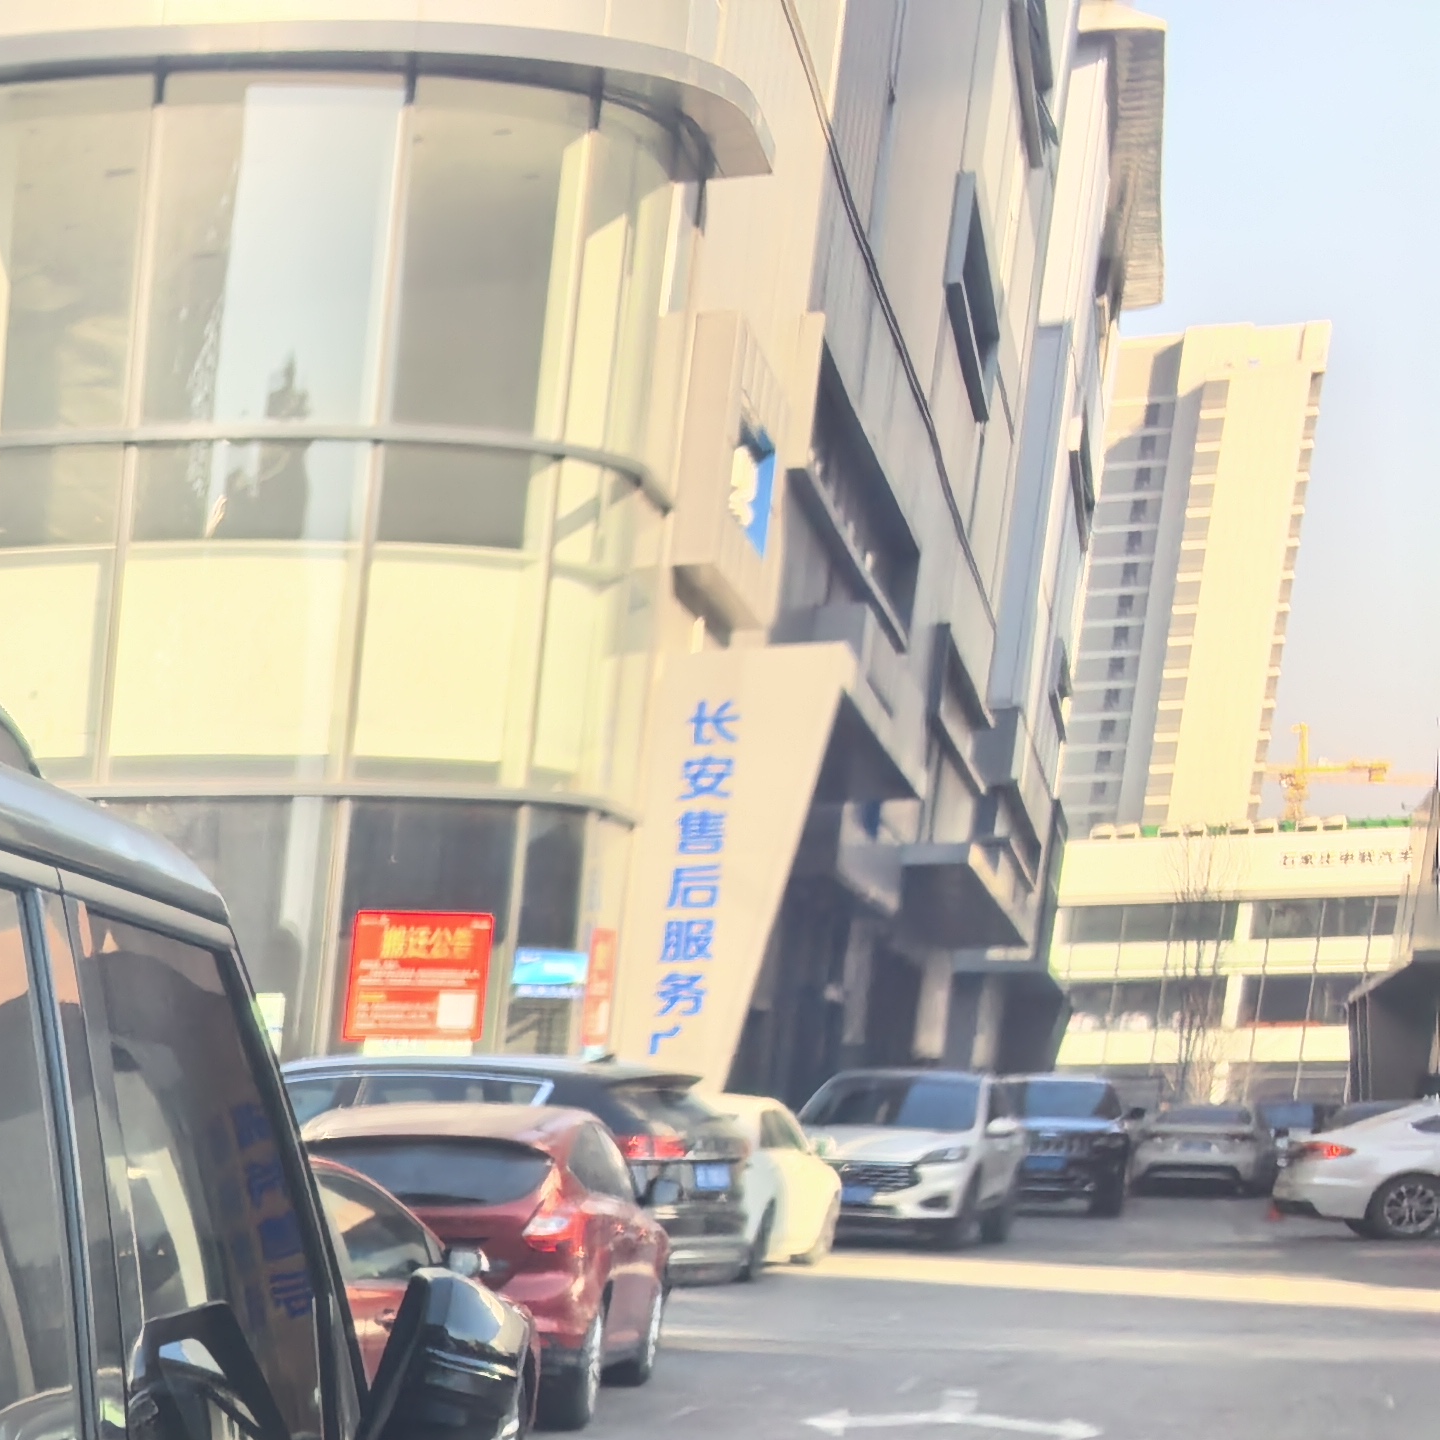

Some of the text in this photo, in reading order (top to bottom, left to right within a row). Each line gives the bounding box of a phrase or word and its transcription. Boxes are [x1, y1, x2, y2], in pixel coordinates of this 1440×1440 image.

[653, 698, 742, 1016] 长安售后服务
